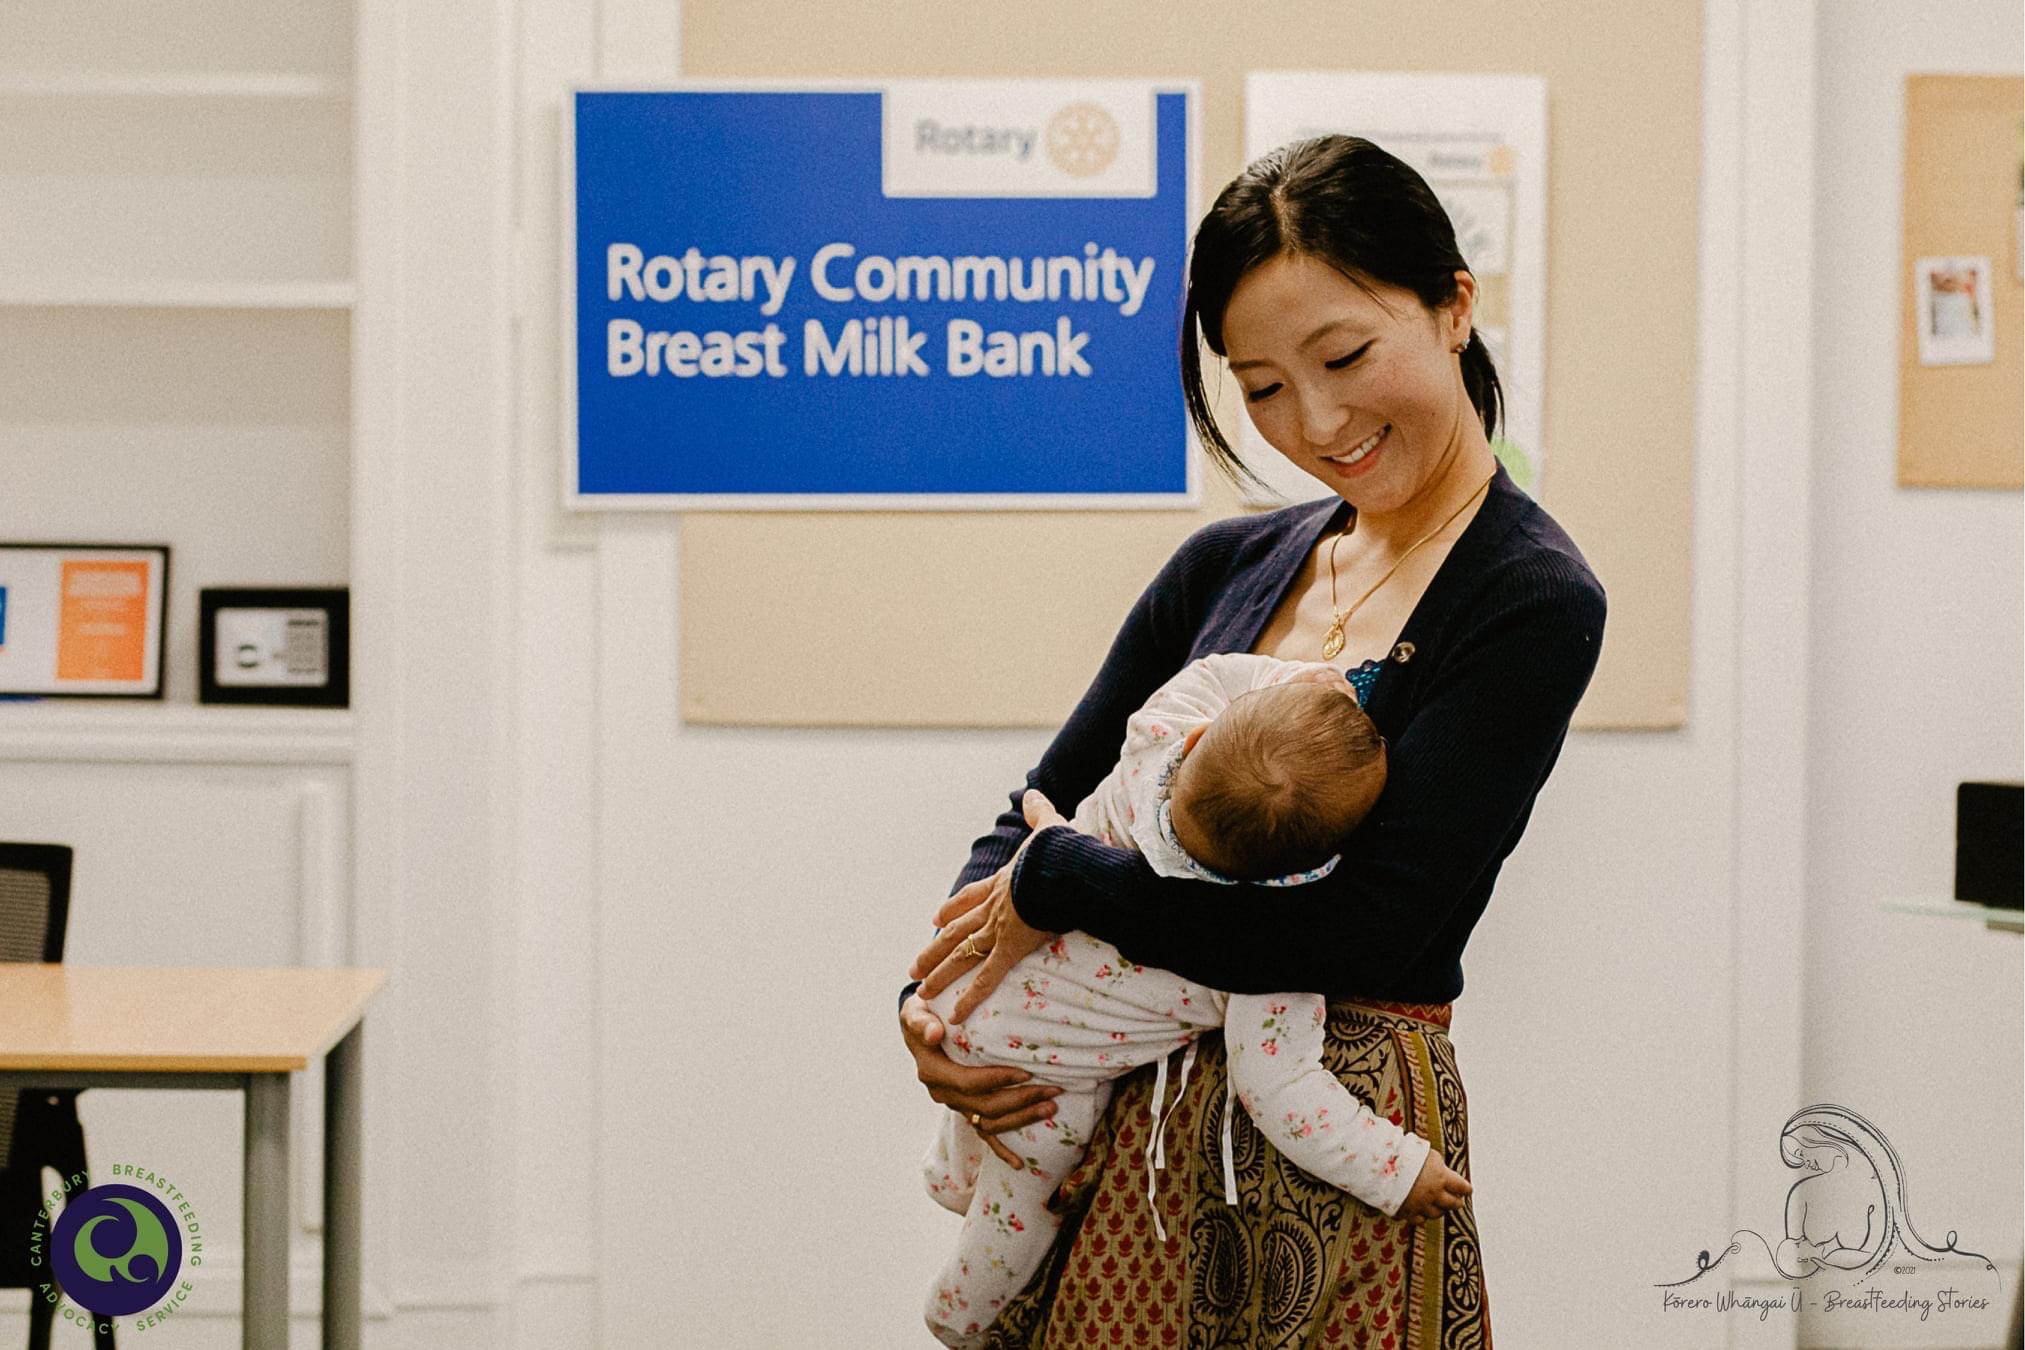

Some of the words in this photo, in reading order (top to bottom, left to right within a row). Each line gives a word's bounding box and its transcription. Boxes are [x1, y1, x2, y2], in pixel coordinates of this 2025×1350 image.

[914, 119, 1038, 163] Rotary
[606, 242, 796, 316] Rotary
[810, 241, 1155, 317] Community
[606, 317, 788, 378] Breast
[803, 315, 930, 378] Milk
[946, 315, 1093, 378] Bank
